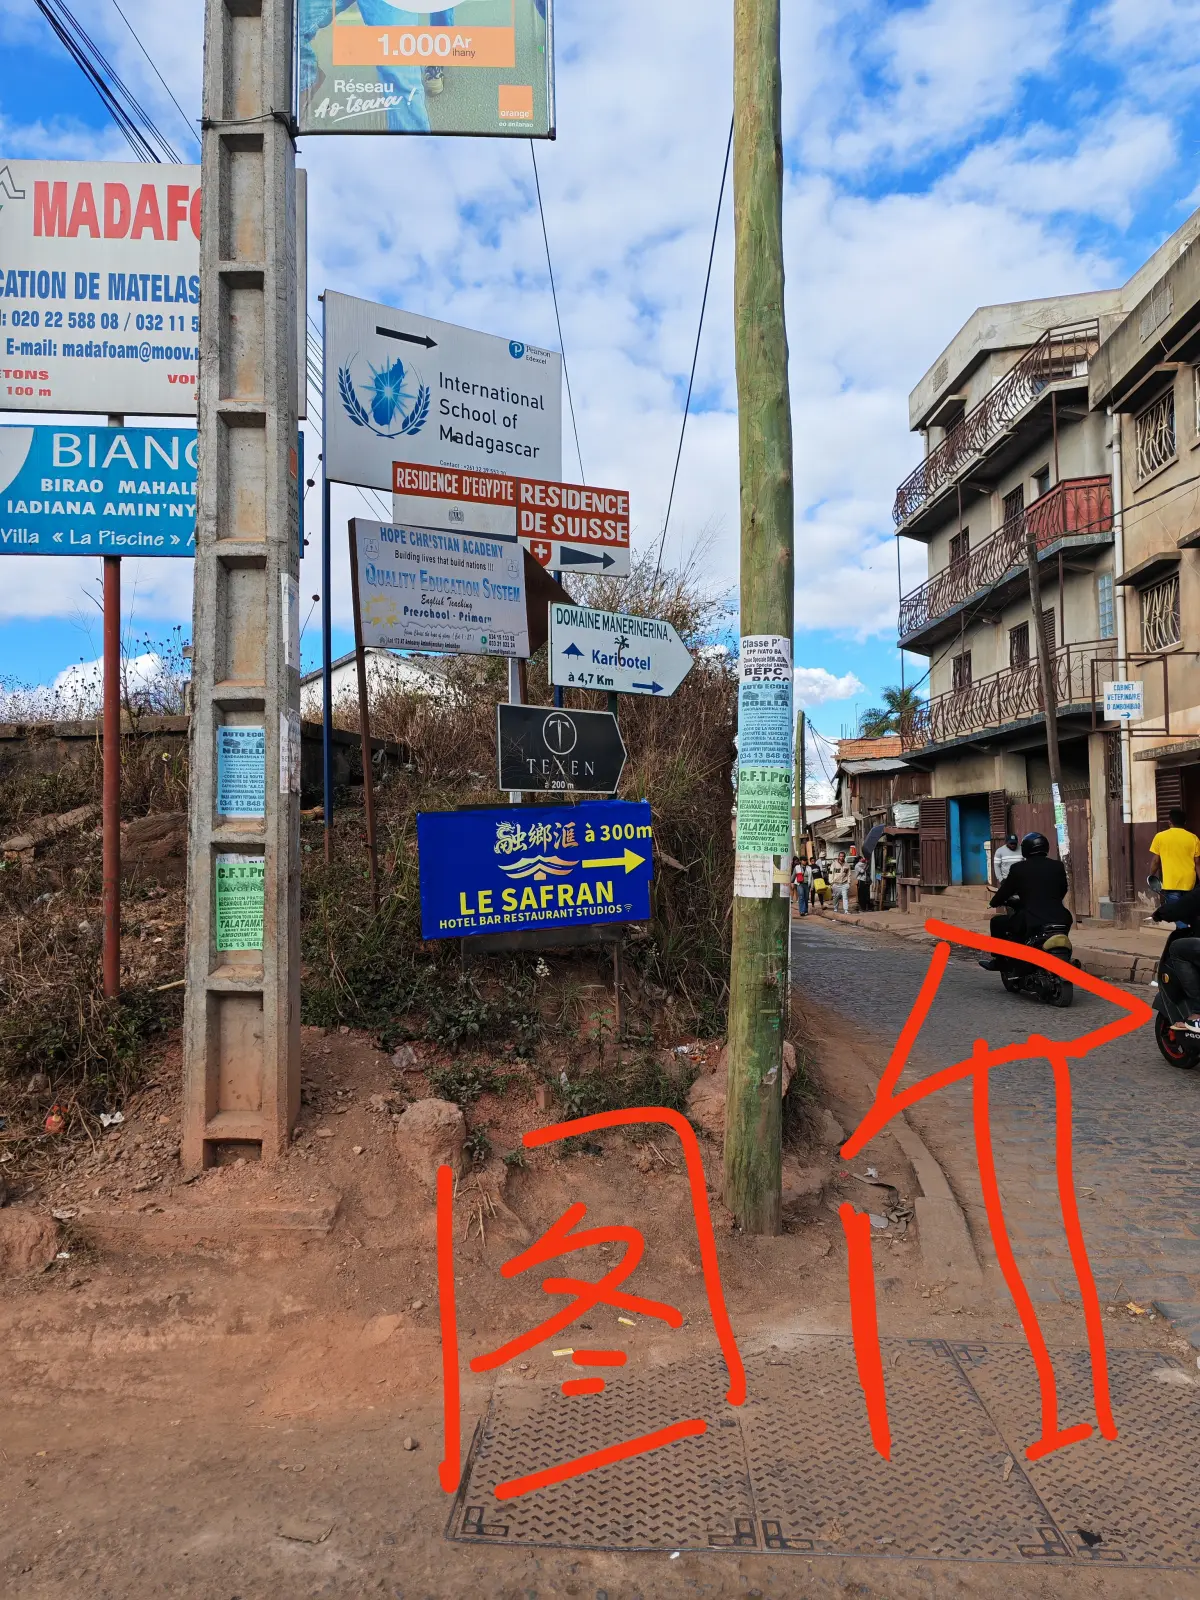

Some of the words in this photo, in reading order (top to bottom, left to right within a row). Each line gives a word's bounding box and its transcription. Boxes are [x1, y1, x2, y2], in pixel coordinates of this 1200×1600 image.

[378, 33, 450, 56] 1.000
[452, 35, 471, 49] Ar
[452, 49, 476, 59] ihany
[334, 79, 394, 93] Réseau
[500, 110, 529, 119] orange
[74, 271, 100, 300] DE
[108, 273, 200, 304] MATELAS
[11, 310, 40, 327] 020
[44, 311, 63, 328] 22
[68, 312, 96, 329] 588
[100, 312, 119, 330] 08
[135, 313, 163, 331] 032
[169, 315, 184, 331] 11
[6, 338, 57, 356] E-mail:
[525, 345, 551, 358] Pearson
[525, 354, 546, 365] Edexcel
[0, 369, 49, 380] TONS
[6, 386, 34, 396] 100
[38, 388, 52, 396] m
[439, 371, 544, 410] International
[439, 398, 497, 425] School
[502, 413, 518, 429] of
[439, 424, 540, 458] Madagascar
[41, 478, 104, 492] BIRAO
[396, 467, 458, 494] RESIDENCE
[463, 476, 514, 500] D'EGYPTE
[7, 500, 96, 515] IADIANA
[520, 483, 628, 516] RESIDENCE
[521, 511, 546, 534] DE
[551, 513, 628, 542] SUISSE
[0, 528, 40, 544] Villa
[70, 529, 91, 544] La
[98, 530, 164, 546] Piscine
[380, 527, 406, 544] HOPE
[462, 539, 504, 558] ACADEMY
[394, 550, 420, 564] Building
[421, 553, 436, 564] lives
[437, 555, 449, 565] that
[450, 557, 464, 568] build
[465, 560, 487, 571] nations
[365, 562, 417, 588] QUALITY
[419, 569, 480, 598] EDUCATION
[482, 577, 520, 602] SYSTEM
[420, 594, 444, 607] English
[403, 606, 450, 620] Preschool
[556, 607, 600, 630] DOMAINE
[602, 616, 669, 641] MANERINERINA
[742, 639, 769, 648] Classe
[568, 672, 574, 682] à
[577, 672, 594, 686] 4,7
[596, 674, 614, 686] Km
[744, 667, 783, 676] BEPC
[526, 755, 594, 776] TEXEN
[551, 780, 565, 789] 200
[740, 770, 790, 783] C.F.T.Pro
[584, 823, 595, 843] à
[600, 822, 653, 842] 300m
[459, 889, 494, 916] LE
[501, 880, 614, 912] SAFRAN
[439, 917, 477, 929] HOTEL
[479, 914, 502, 926] BAR
[503, 908, 573, 923] RESTAURANT
[576, 904, 623, 917] STUDIOS
